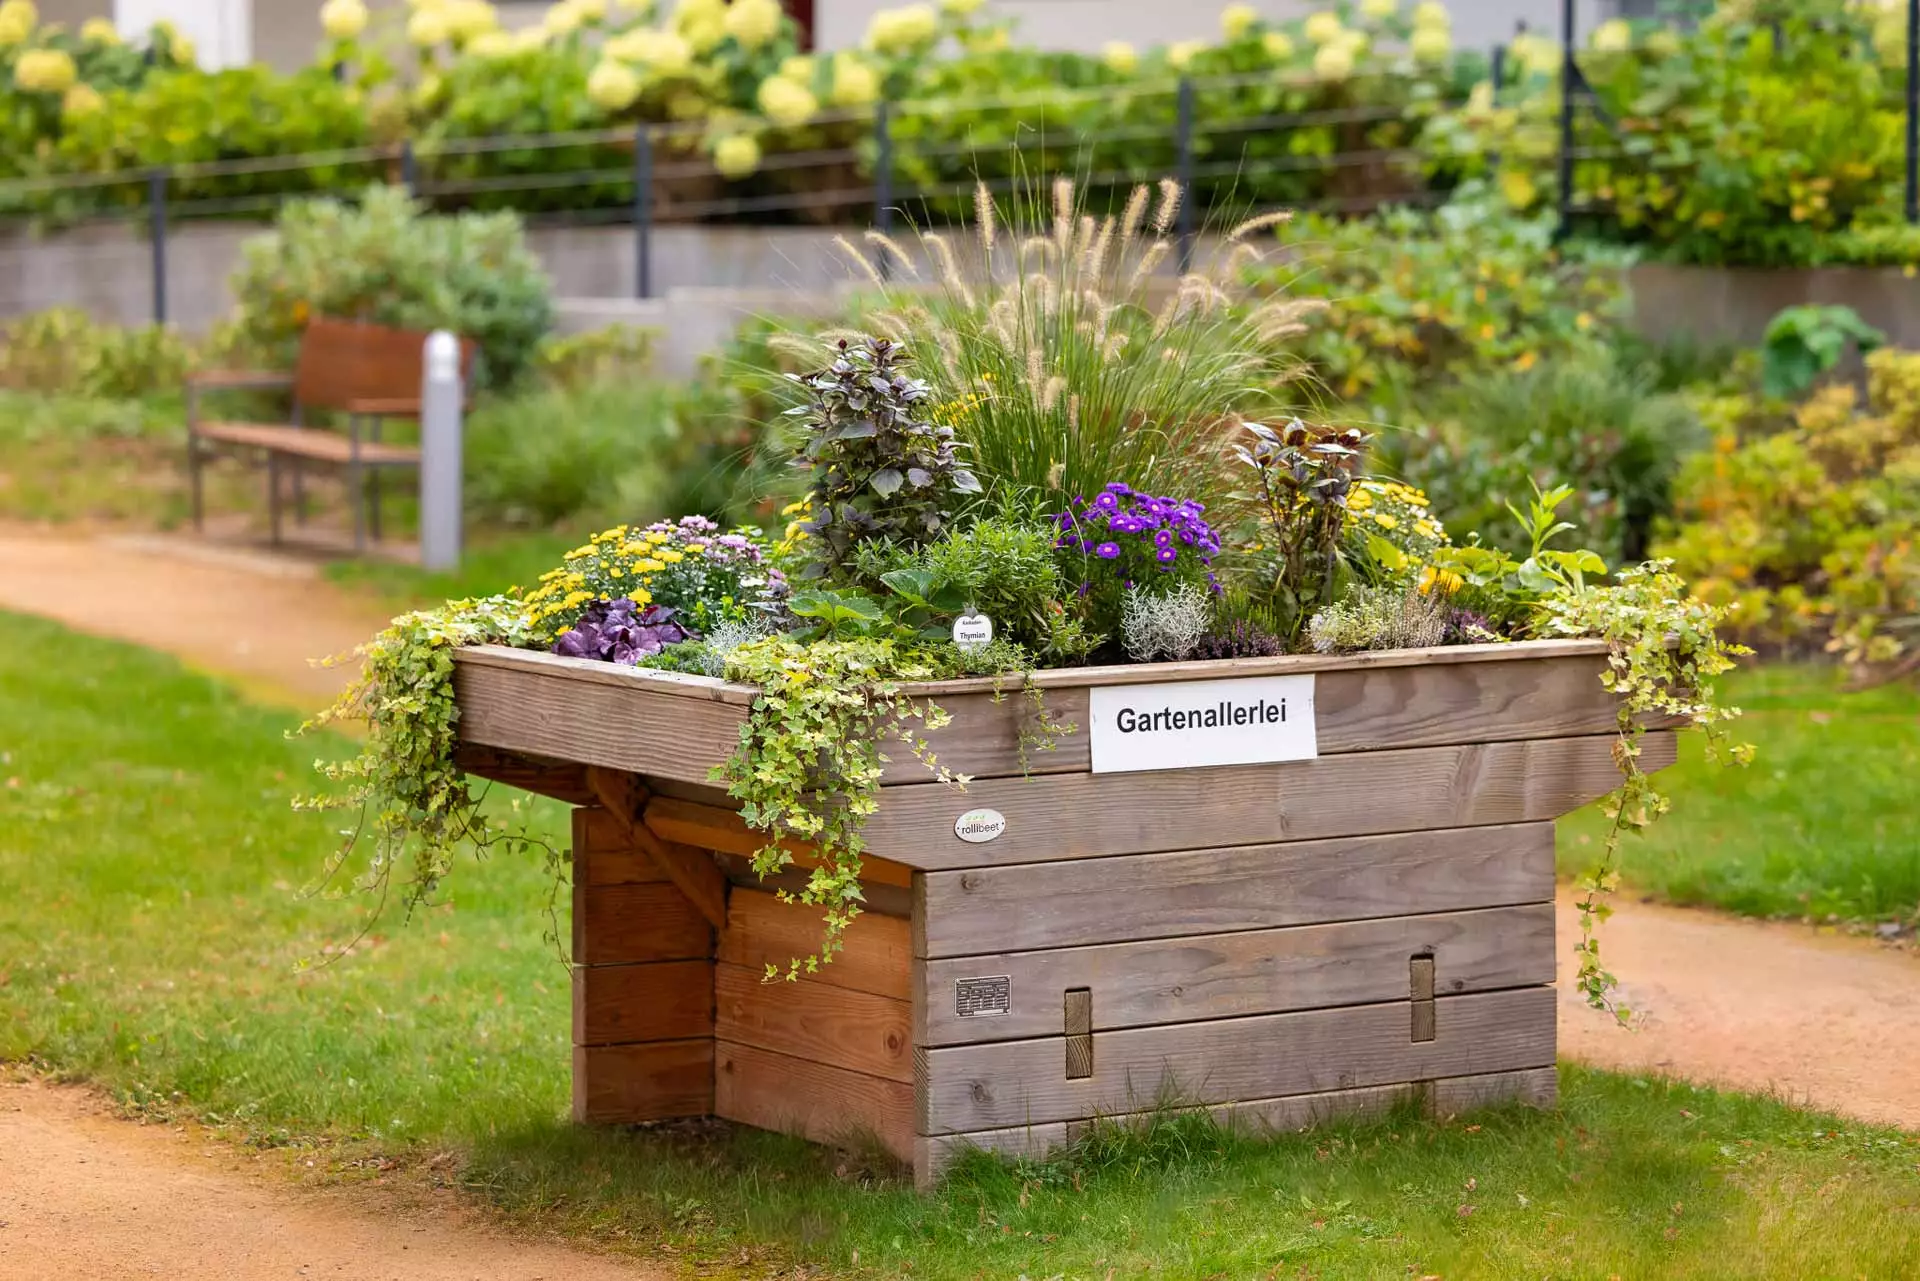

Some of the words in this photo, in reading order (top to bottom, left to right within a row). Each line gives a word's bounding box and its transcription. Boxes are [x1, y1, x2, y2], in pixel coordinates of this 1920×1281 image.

[960, 632, 986, 641] Thymian
[1116, 698, 1287, 733] Gartenallerlei
[961, 823, 1000, 834] rollibeet
